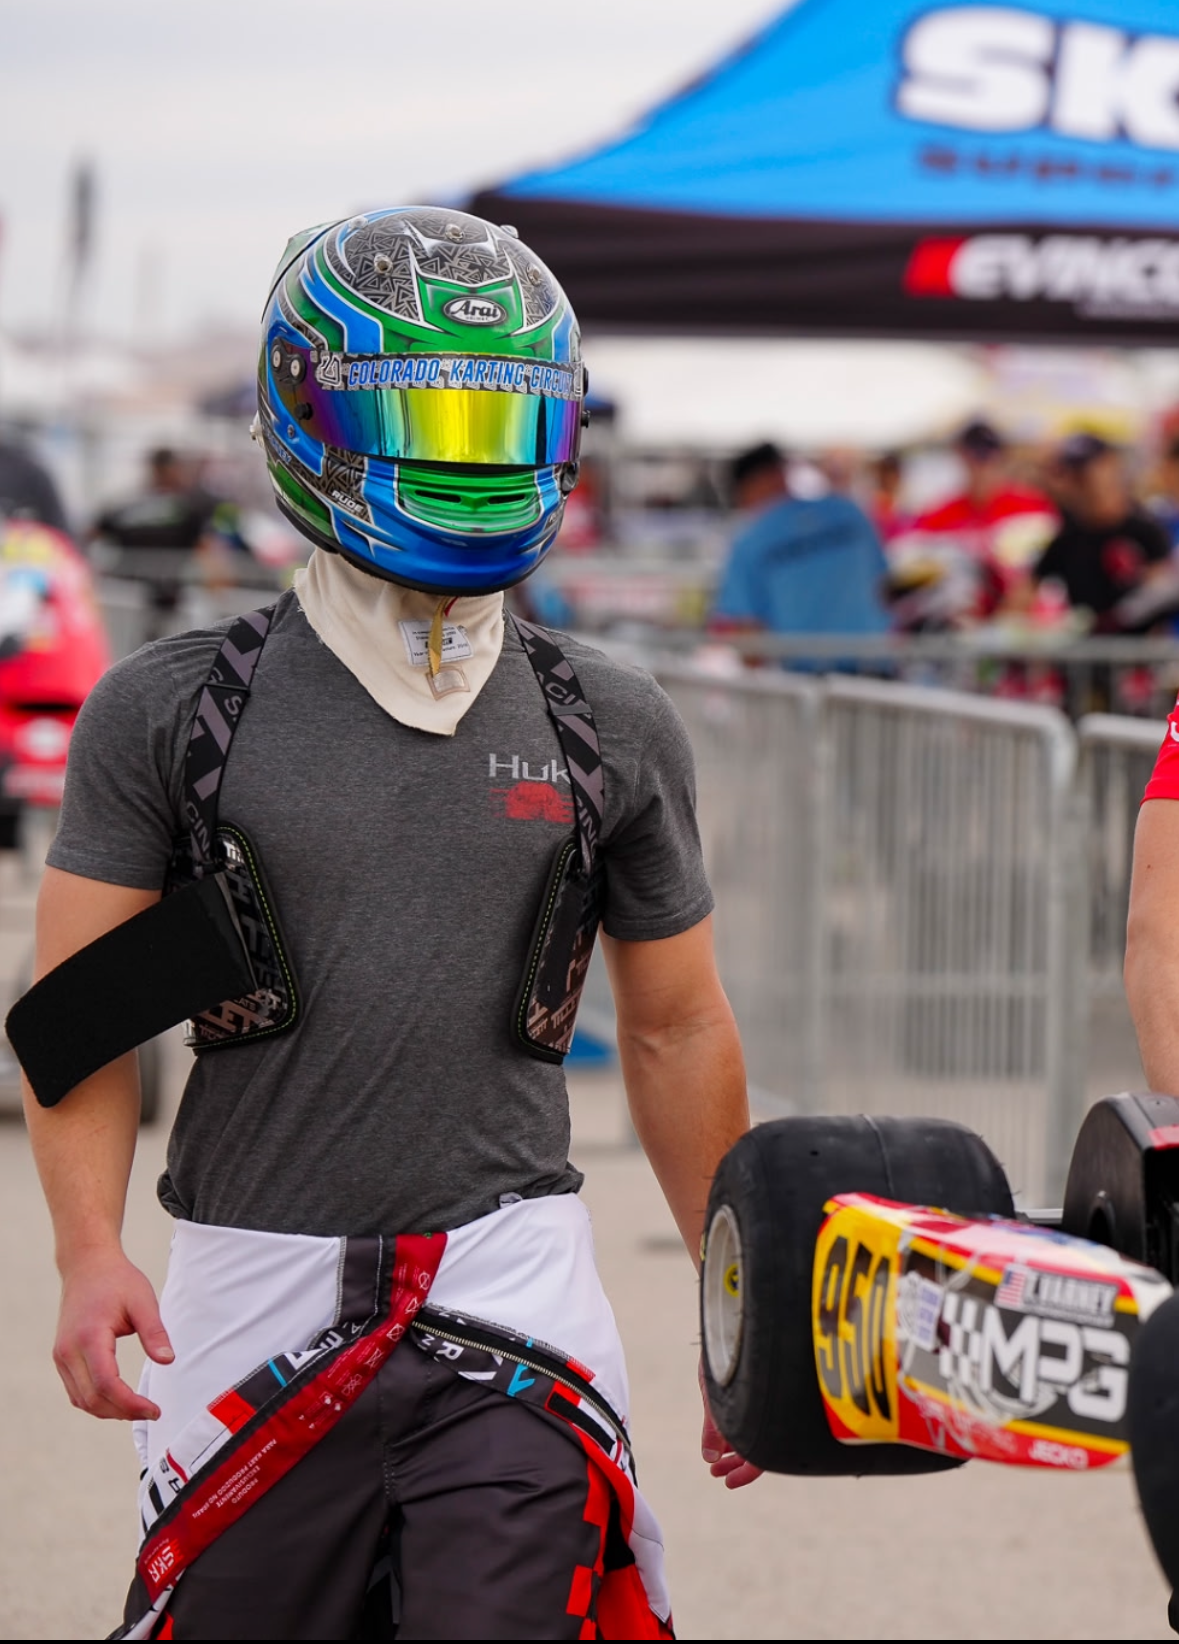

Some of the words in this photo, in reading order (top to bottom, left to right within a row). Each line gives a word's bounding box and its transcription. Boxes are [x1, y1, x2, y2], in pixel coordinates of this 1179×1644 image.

[450, 300, 500, 318] Arai
[348, 358, 440, 386] COLORADO
[450, 359, 525, 386] KARTING
[530, 366, 573, 395] CIRCUIT
[331, 490, 364, 513] RUDE
[489, 753, 571, 784] Huk
[980, 1304, 1130, 1422] MPG
[262, 1439, 277, 1454] PARA
[247, 1452, 263, 1468] KART
[216, 1465, 260, 1508] EXCLUSIVAMENTE
[217, 1466, 249, 1496] PRODUZIDO
[231, 1478, 258, 1504] PRODUTO
[208, 1494, 219, 1505] NO
